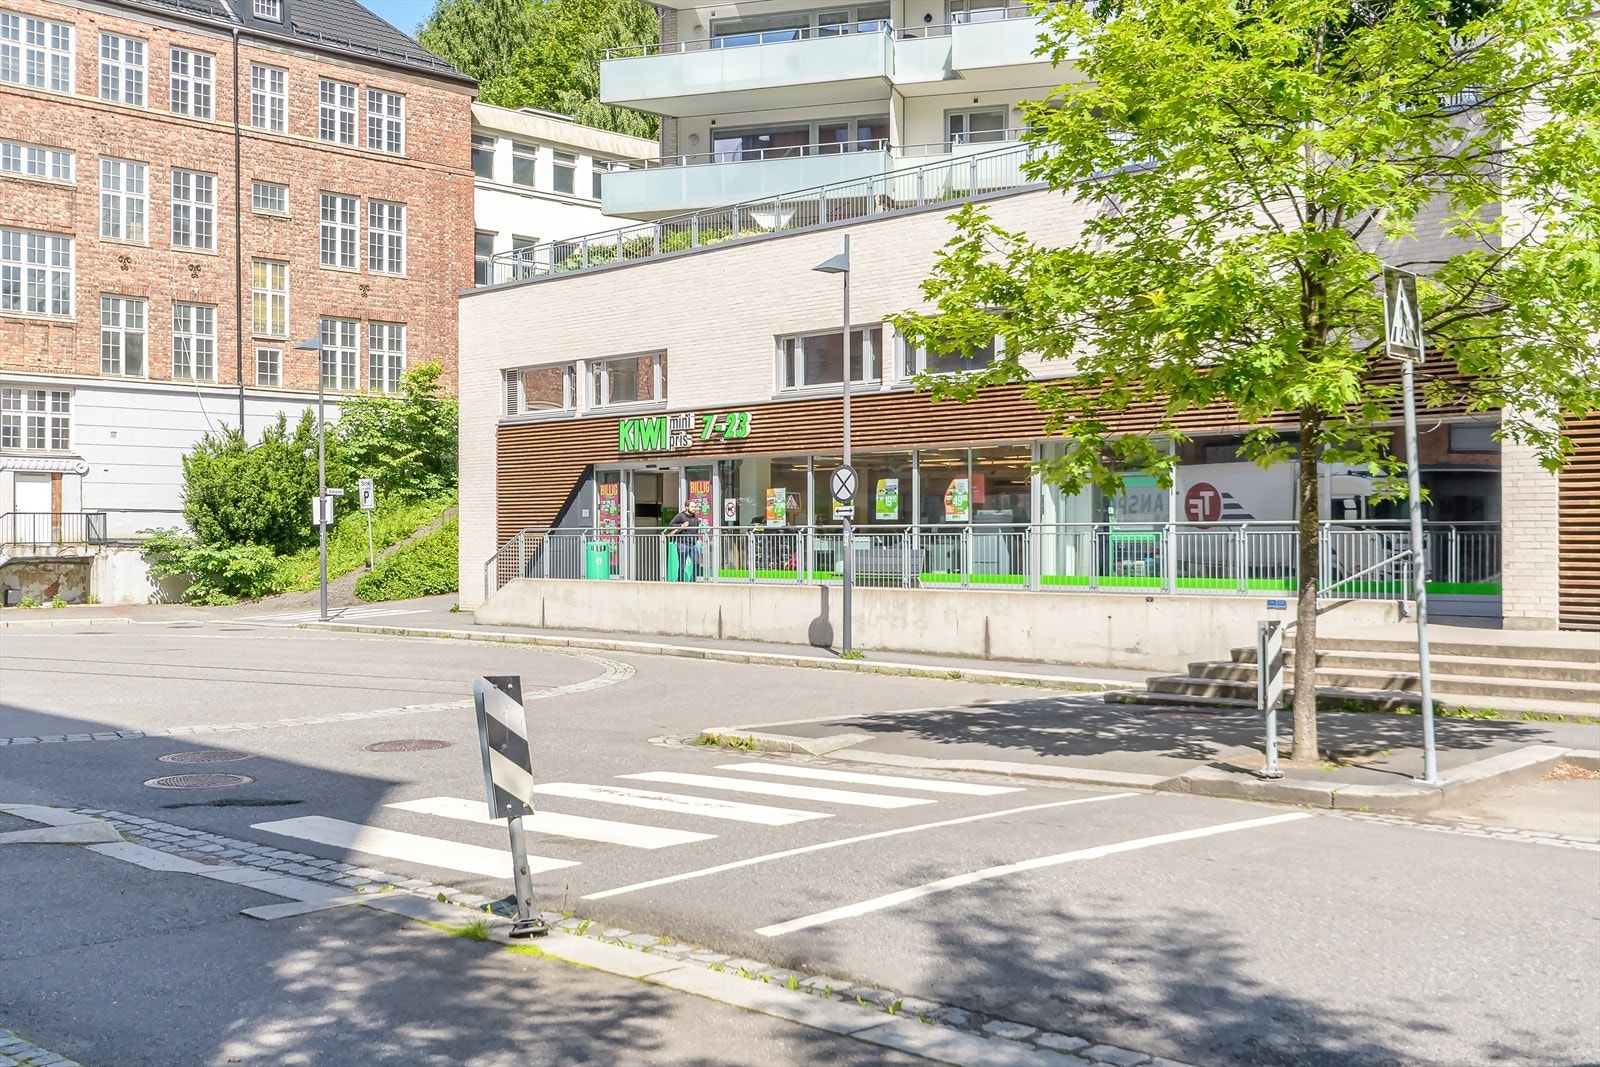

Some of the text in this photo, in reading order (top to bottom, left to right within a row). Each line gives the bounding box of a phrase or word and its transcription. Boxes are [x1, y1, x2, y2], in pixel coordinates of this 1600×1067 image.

[669, 413, 691, 430] mini
[619, 416, 667, 452] KIWI
[669, 432, 689, 450] pris
[601, 484, 618, 496] BILLIG
[690, 482, 710, 494] BILLIG
[364, 491, 370, 503] P
